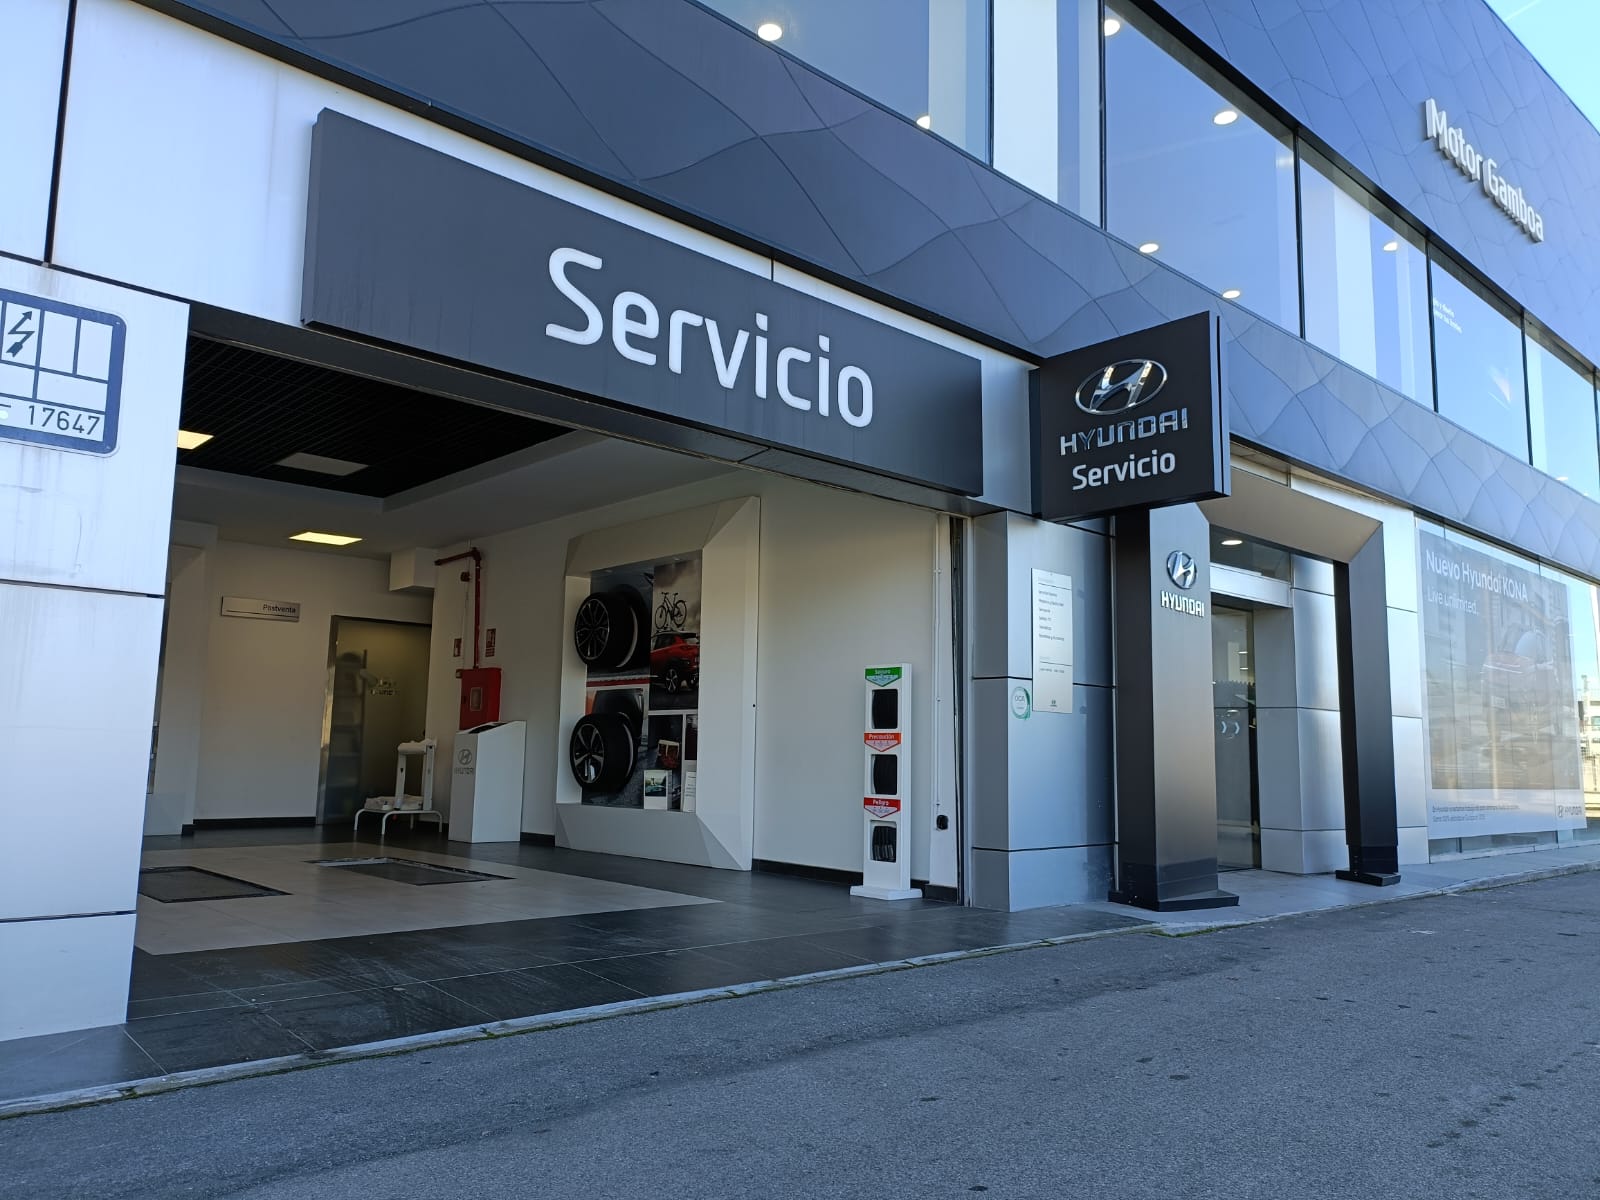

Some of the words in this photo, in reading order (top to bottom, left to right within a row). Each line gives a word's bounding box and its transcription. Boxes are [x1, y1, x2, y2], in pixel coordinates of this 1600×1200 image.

[1425, 98, 1483, 181] Motor
[1483, 158, 1544, 242] Gamboa
[545, 247, 874, 428] Servicio
[28, 404, 101, 436] 17647
[1059, 407, 1189, 456] HYUNDAI
[1072, 449, 1176, 491] Servicio
[1426, 549, 1460, 580] Nuevo
[1461, 561, 1502, 594] Hyundai
[1502, 575, 1529, 602] KONA
[262, 603, 297, 614] Postventa
[1161, 590, 1205, 617] HYUNDAI
